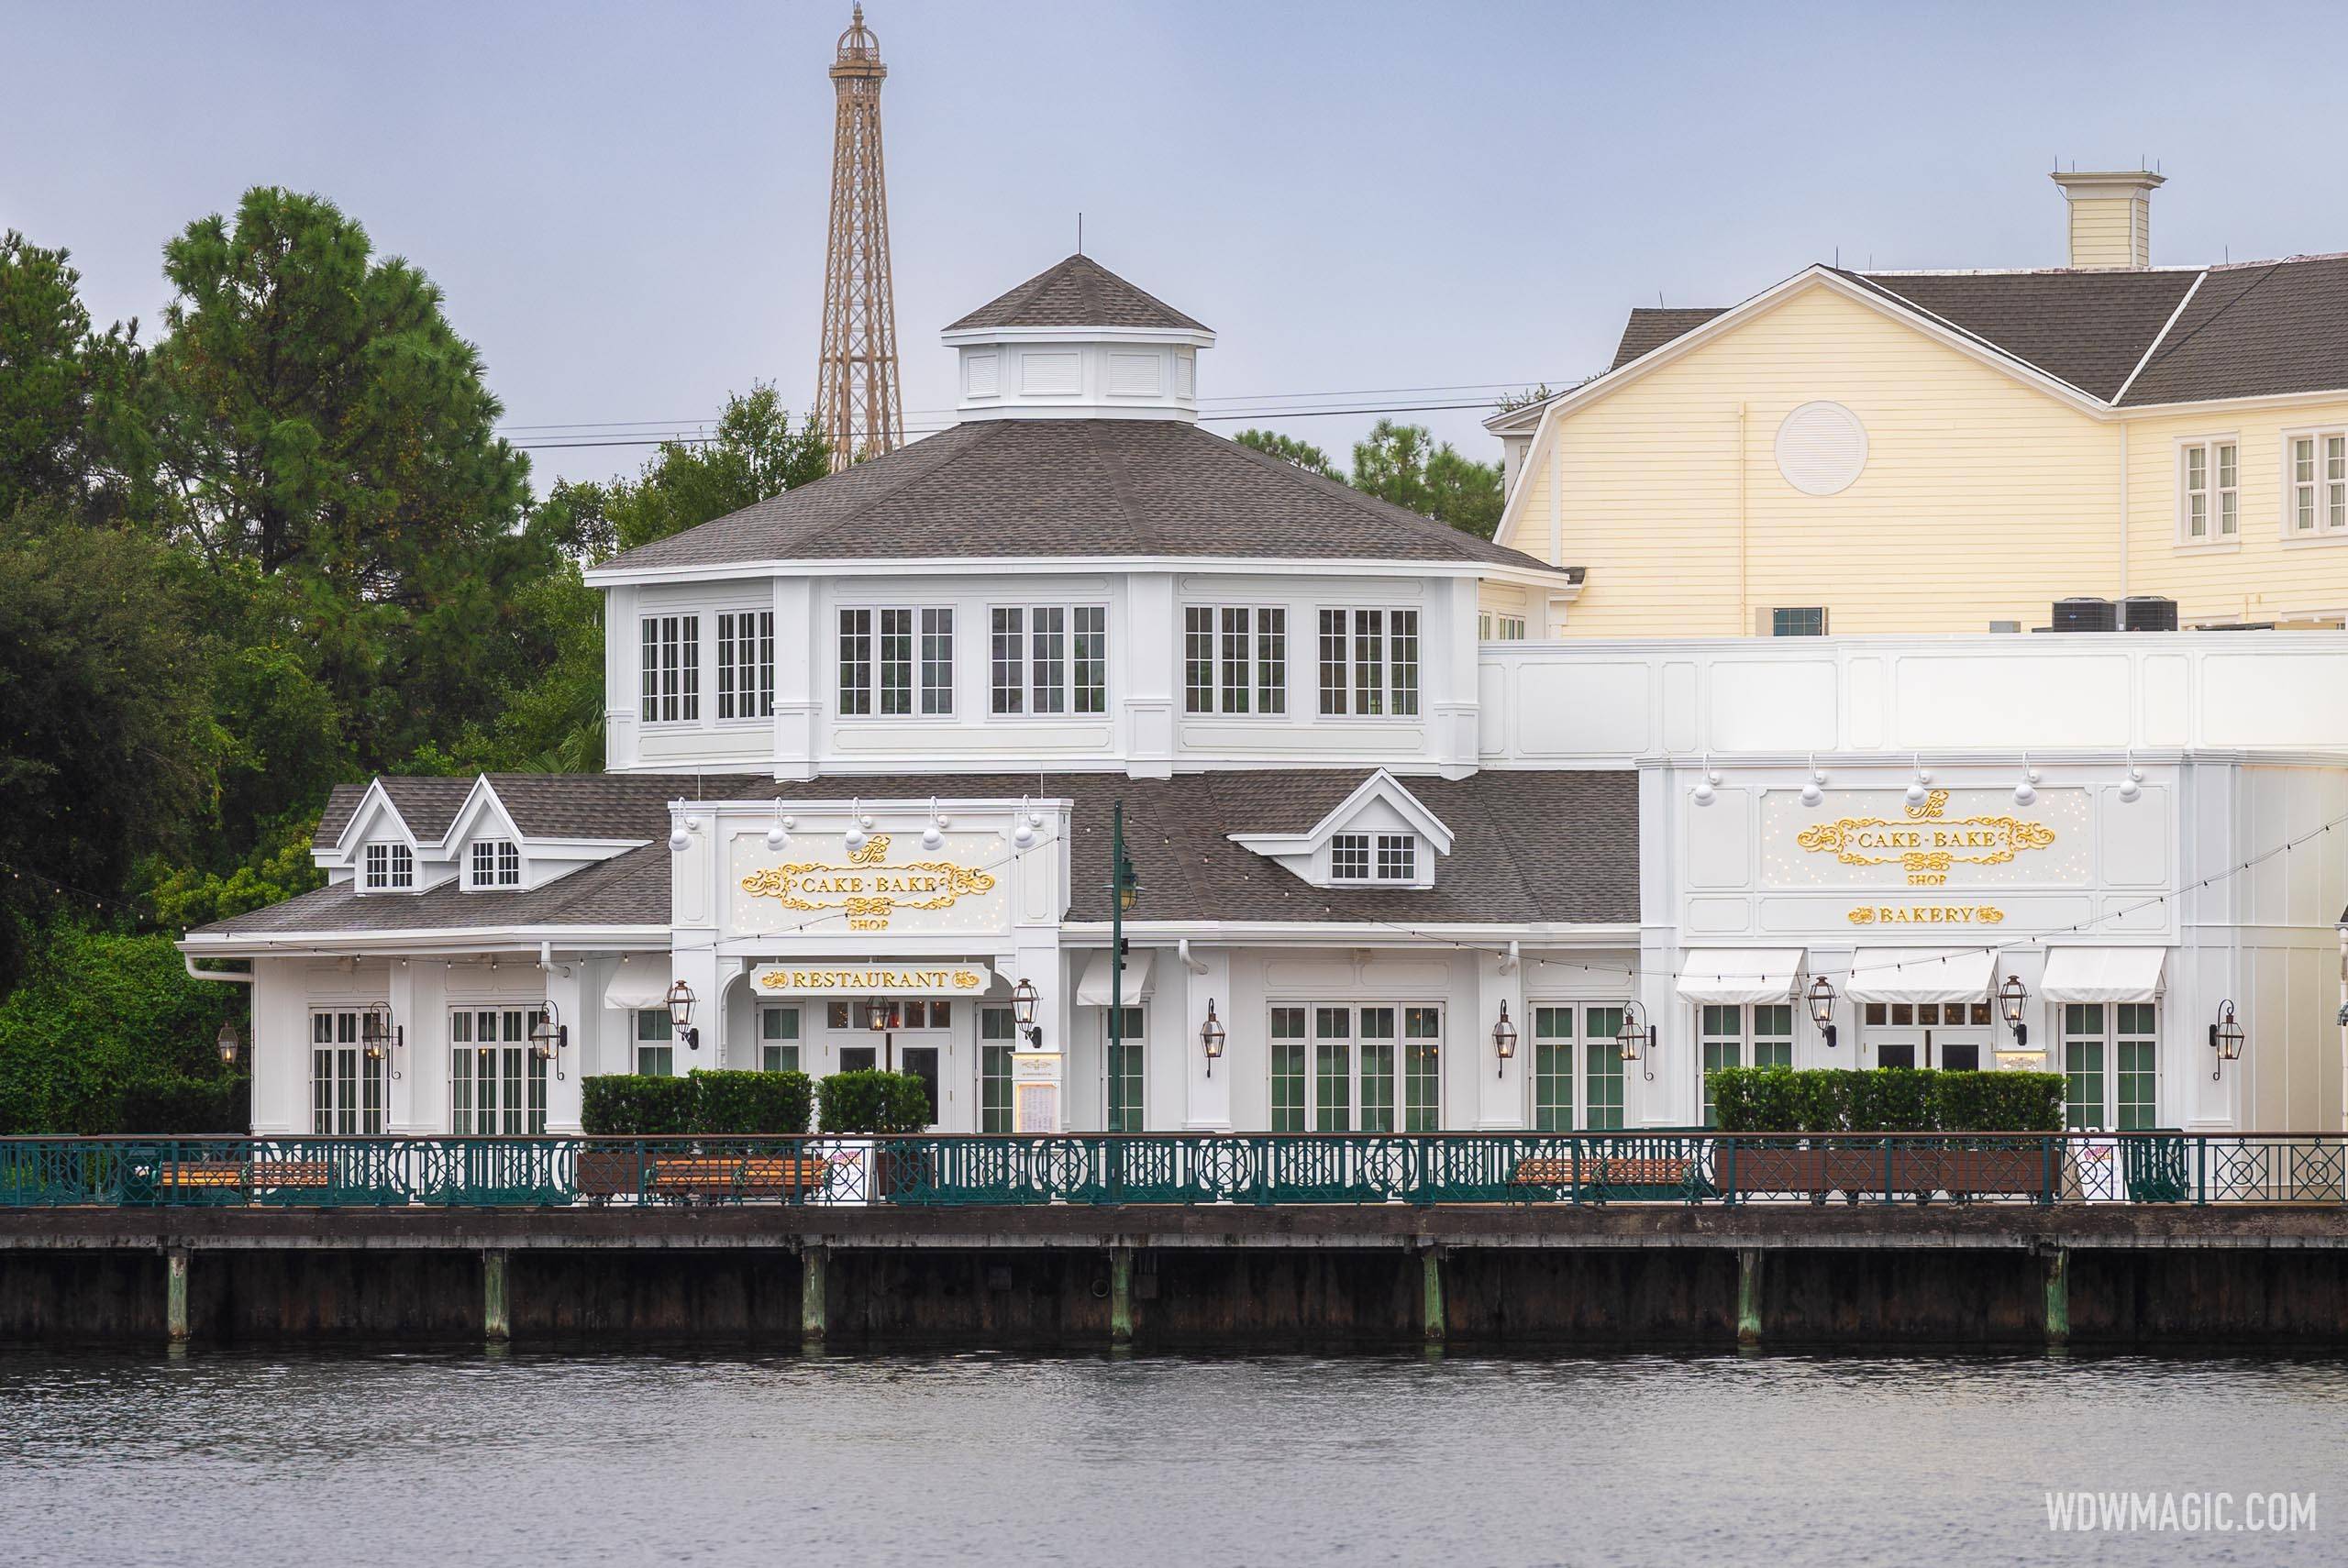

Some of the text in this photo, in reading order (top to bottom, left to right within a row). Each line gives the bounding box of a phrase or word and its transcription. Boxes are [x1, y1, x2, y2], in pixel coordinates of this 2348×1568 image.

[1858, 832, 1997, 848] CAKE BAKE
[802, 877, 936, 892] CAKE BAKE
[1907, 875, 1947, 886] SHOP
[1879, 907, 1975, 923] BAKERY
[849, 920, 889, 931] SHOP
[792, 972, 948, 988] RESTAURANT
